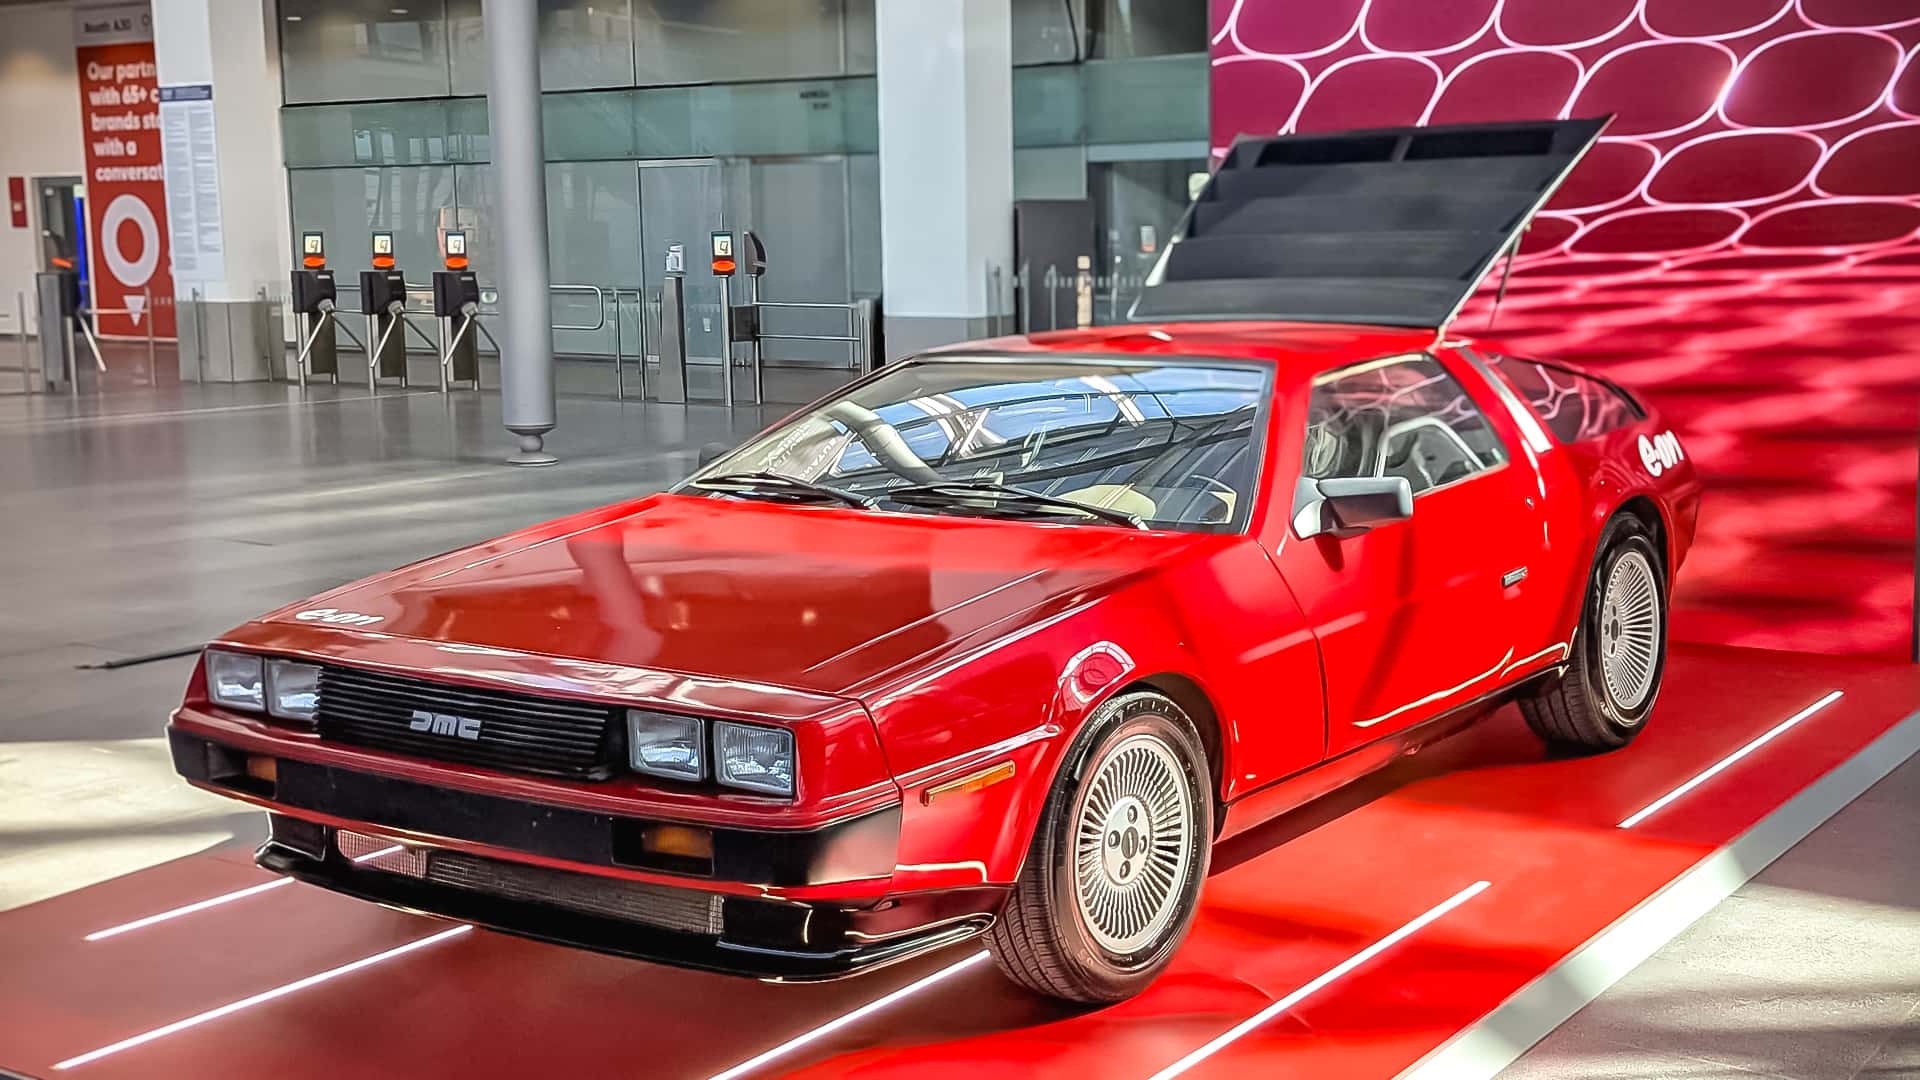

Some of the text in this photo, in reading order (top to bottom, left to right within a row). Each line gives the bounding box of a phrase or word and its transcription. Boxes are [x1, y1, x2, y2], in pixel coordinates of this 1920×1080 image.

[87, 61, 114, 80] Our
[88, 86, 121, 106] with
[121, 84, 148, 105] 65+
[90, 110, 141, 132] brands
[92, 137, 138, 156] with a
[409, 709, 482, 741] DMC
